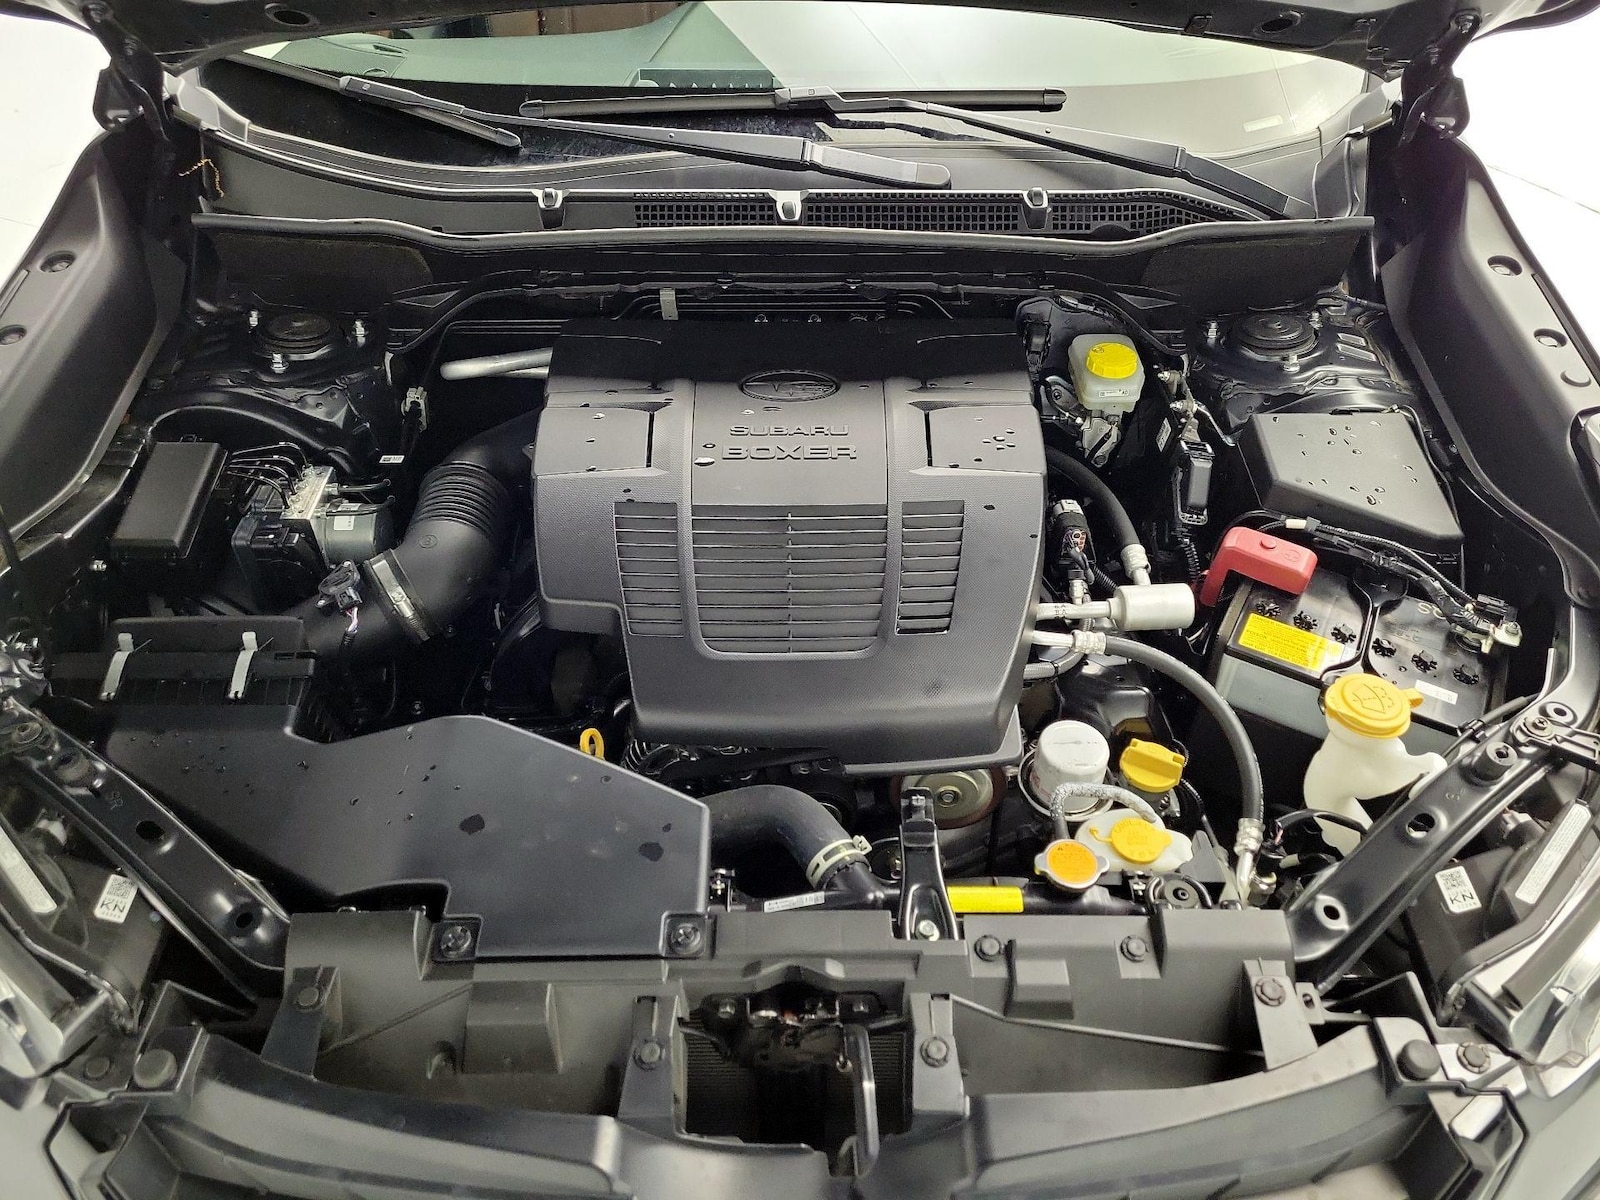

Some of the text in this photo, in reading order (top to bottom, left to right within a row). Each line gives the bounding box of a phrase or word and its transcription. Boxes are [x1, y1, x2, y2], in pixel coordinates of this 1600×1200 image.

[730, 424, 849, 436] SUBARU
[722, 445, 857, 460] BOXER
[1449, 891, 1475, 905] KN
[100, 900, 126, 913] KN
